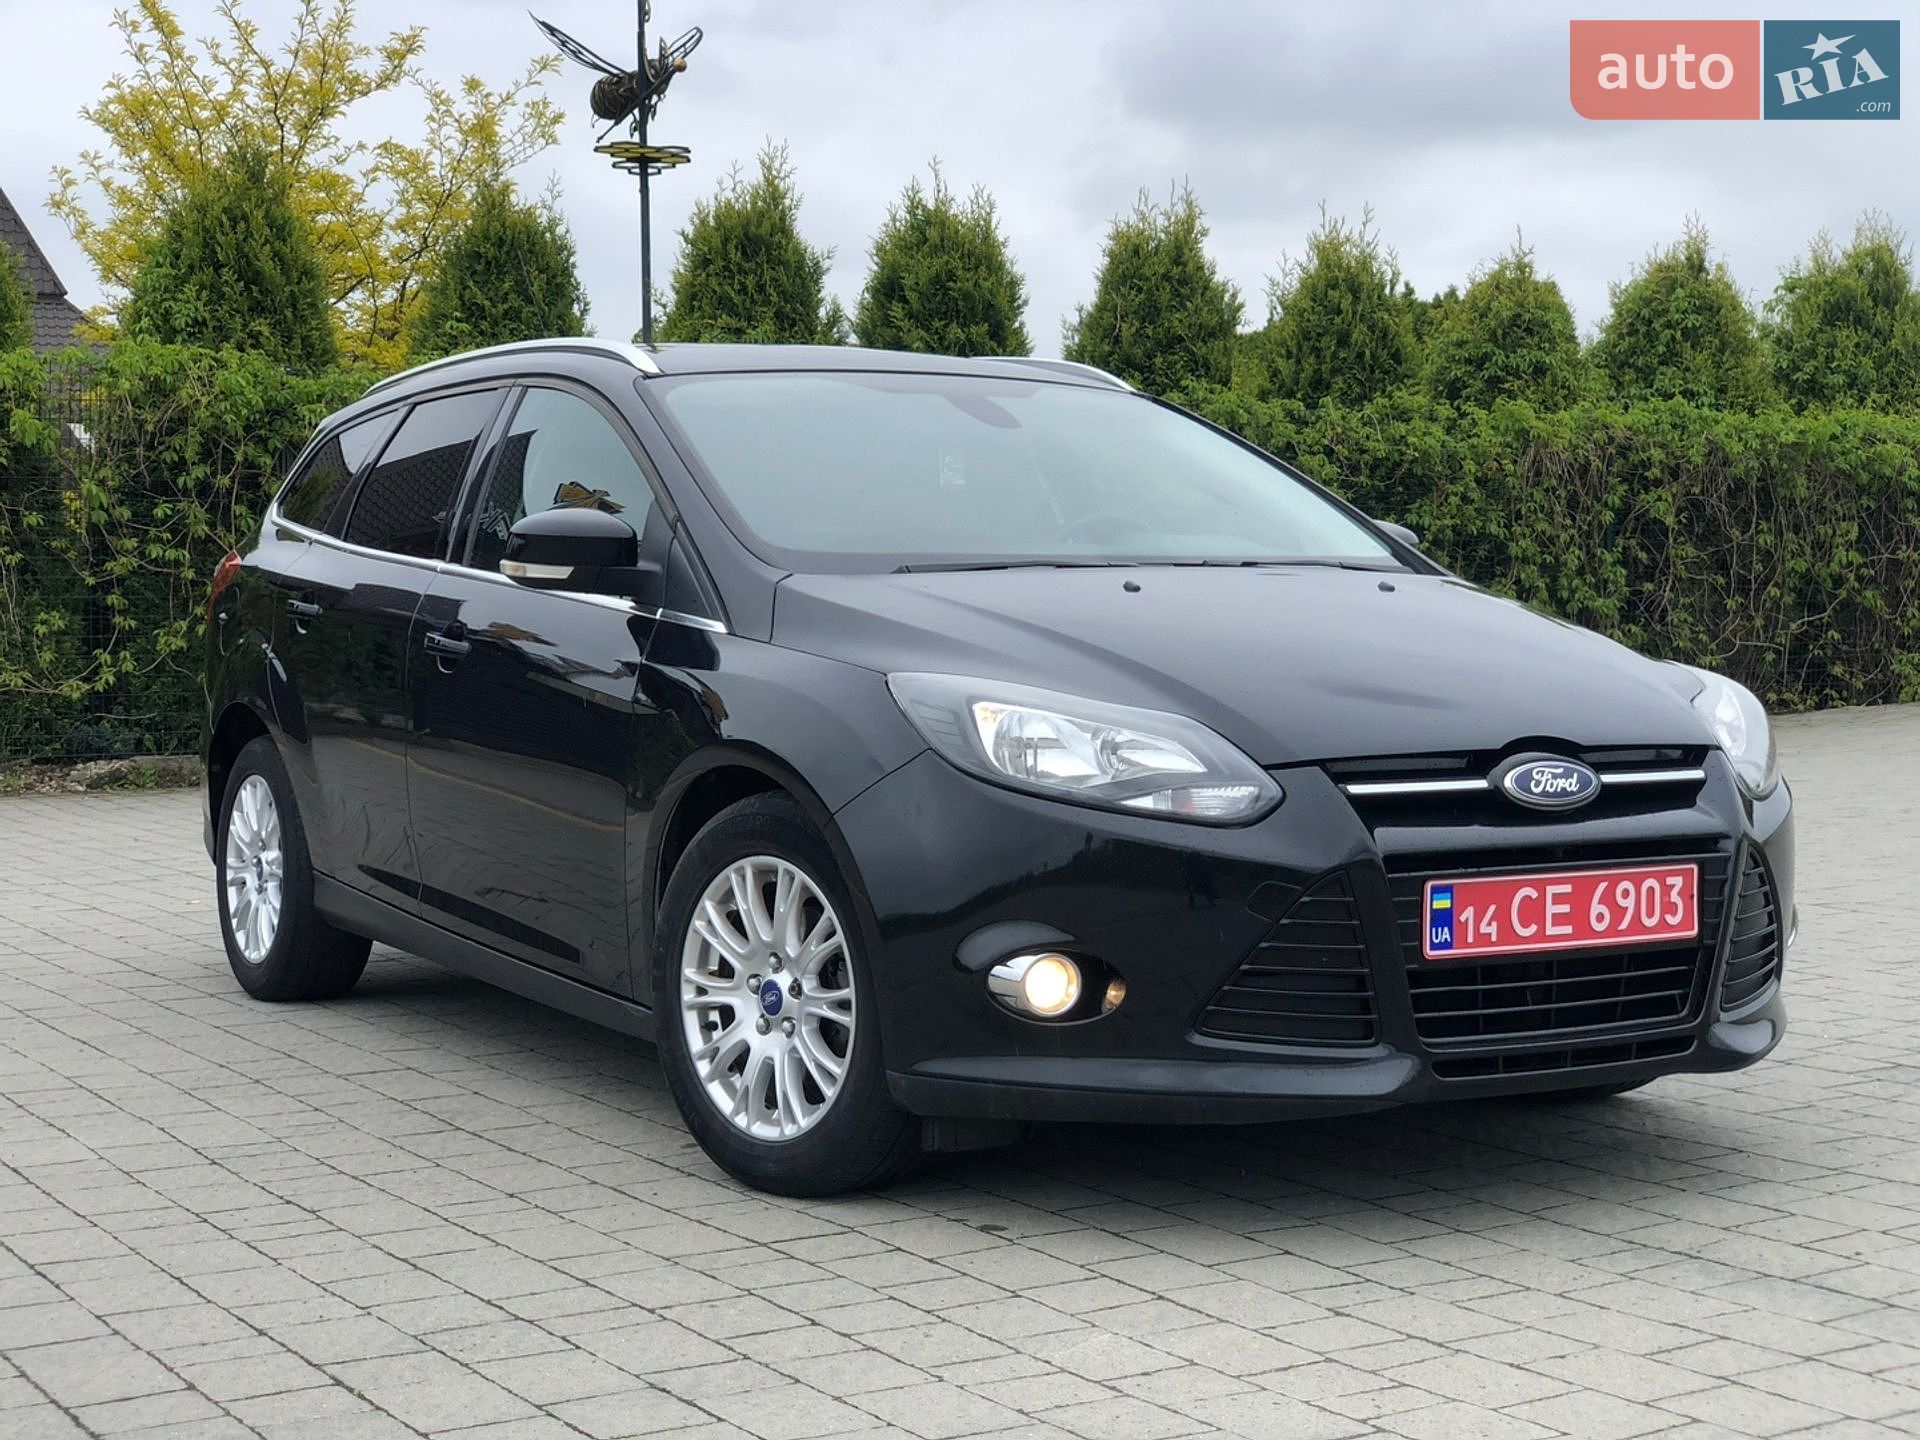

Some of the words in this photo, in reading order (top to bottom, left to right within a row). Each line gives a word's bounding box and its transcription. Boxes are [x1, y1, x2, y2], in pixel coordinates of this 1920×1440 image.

[1530, 767, 1580, 793] Ford
[1459, 904, 1498, 943] 14
[1510, 884, 1574, 938] CE
[1588, 875, 1685, 933] 6903
[1431, 926, 1451, 943] UA
